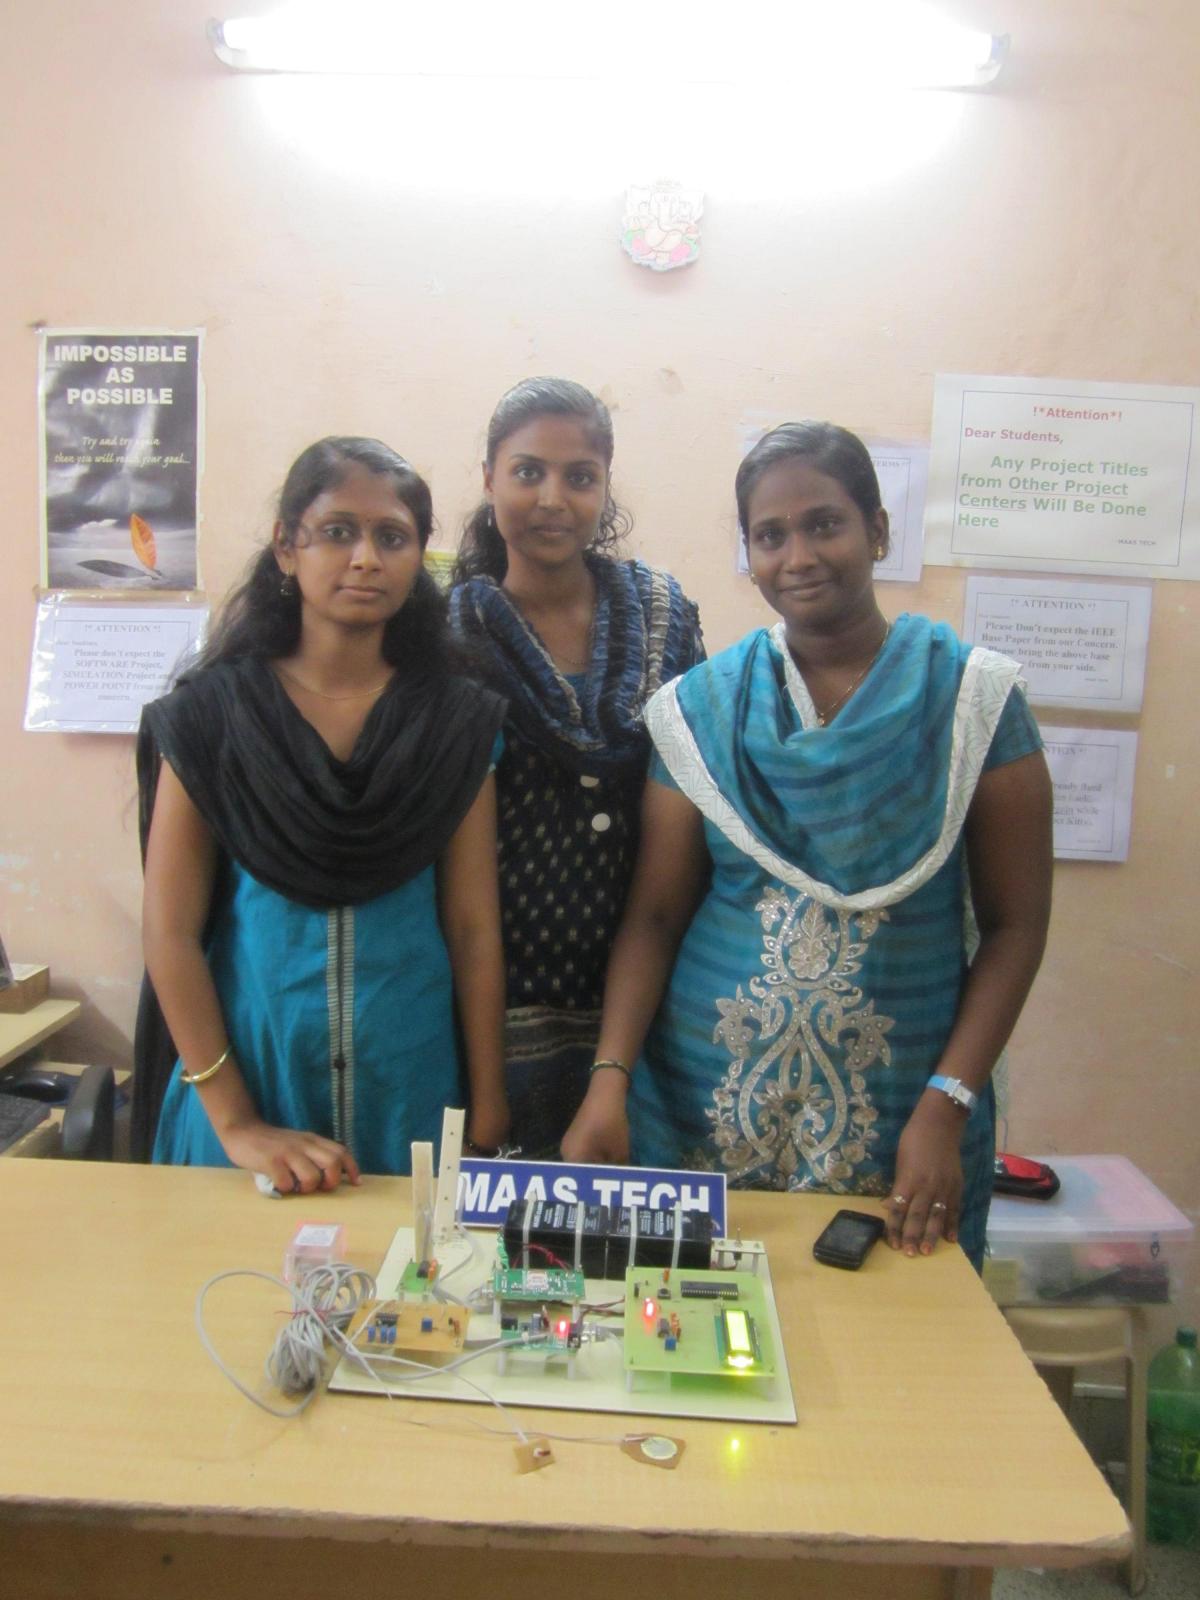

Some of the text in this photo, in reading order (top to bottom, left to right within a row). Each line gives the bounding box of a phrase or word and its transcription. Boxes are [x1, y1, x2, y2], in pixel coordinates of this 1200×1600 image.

[54, 345, 187, 363] IMPOSSIBLE
[106, 367, 135, 384] AS
[67, 388, 173, 405] POSSIBLE
[964, 427, 1064, 444] Dear Students,
[82, 436, 97, 449] Try
[99, 436, 118, 447] and
[54, 452, 74, 463] then
[94, 453, 113, 463] will
[990, 455, 1149, 478] Any Project Titles
[960, 474, 1129, 497] from Other Project
[959, 493, 1147, 517] Centers Will Be Done
[957, 513, 999, 528] Here
[1023, 599, 1085, 610] ATTENTION
[95, 624, 151, 634] ATTENTION
[985, 621, 1013, 631] Please
[1043, 626, 1073, 635] expect
[1074, 626, 1089, 635] the
[1005, 634, 1031, 645] Paper
[1033, 635, 1057, 645] from
[1059, 638, 1075, 646] our
[124, 649, 151, 659] expect
[152, 650, 166, 658] the
[1018, 648, 1043, 658] bring
[1045, 649, 1059, 658] the
[1061, 650, 1088, 660] above
[75, 659, 130, 669] SOFTWARE
[1027, 660, 1051, 669] from
[1053, 662, 1074, 673] your
[126, 671, 156, 681] Project
[64, 681, 99, 691] POWER
[101, 682, 132, 691] POINT
[455, 1172, 710, 1212] MAAS TECH
